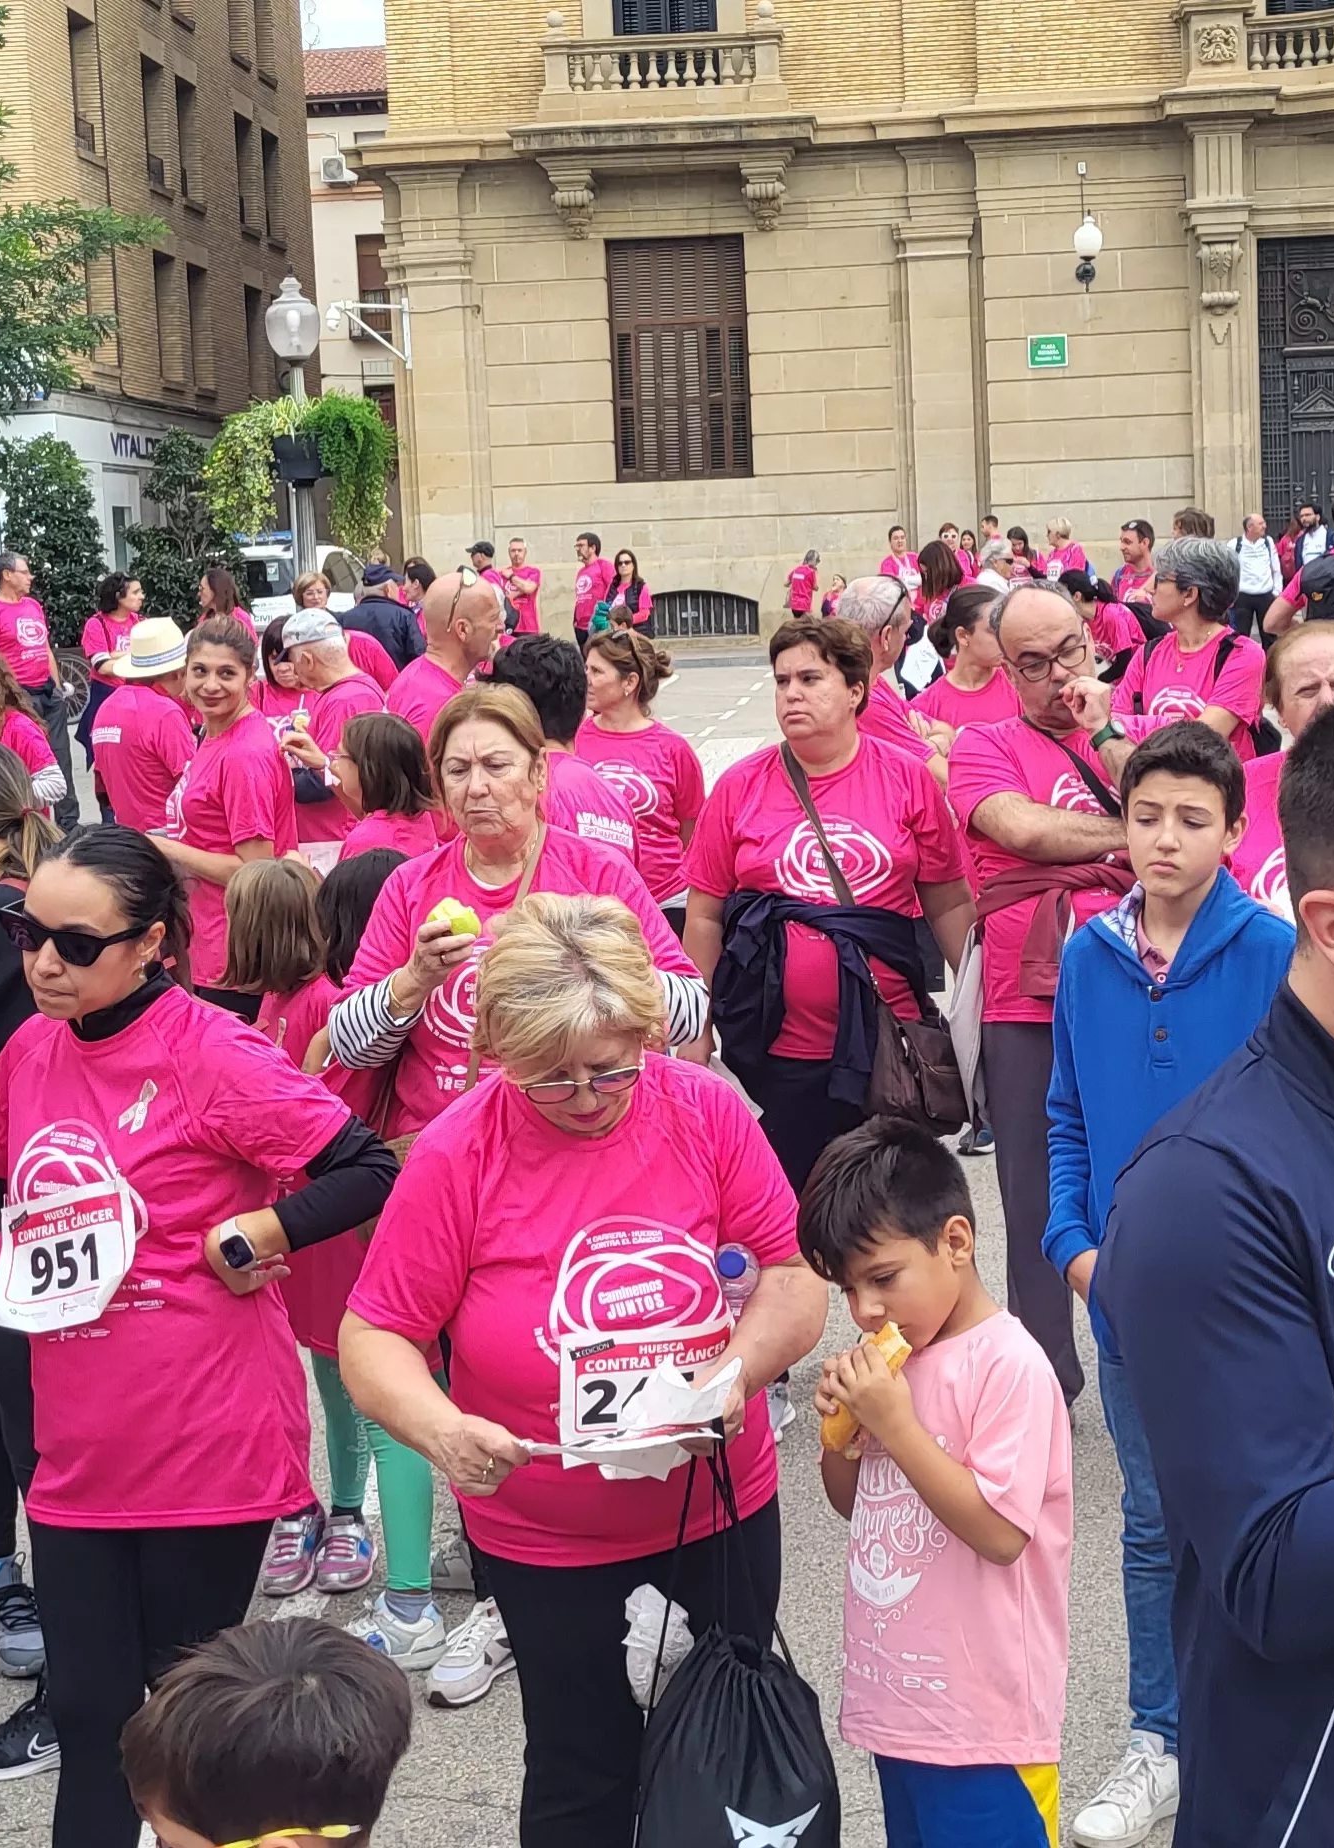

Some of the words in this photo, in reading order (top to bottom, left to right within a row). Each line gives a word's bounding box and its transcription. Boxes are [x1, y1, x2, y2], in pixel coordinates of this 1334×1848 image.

[17, 1223, 55, 1243] CONTRA
[57, 1219, 70, 1232] EL
[71, 1208, 114, 1228] CÁNCER
[43, 1205, 75, 1221] HUESCA
[30, 1233, 100, 1296] 951
[597, 1279, 664, 1305] Caminemos
[607, 1293, 665, 1320] JUNTOS
[584, 1357, 651, 1373] CONTRA
[675, 1339, 726, 1365] CÁNCER
[639, 1341, 685, 1355] HUESCA
